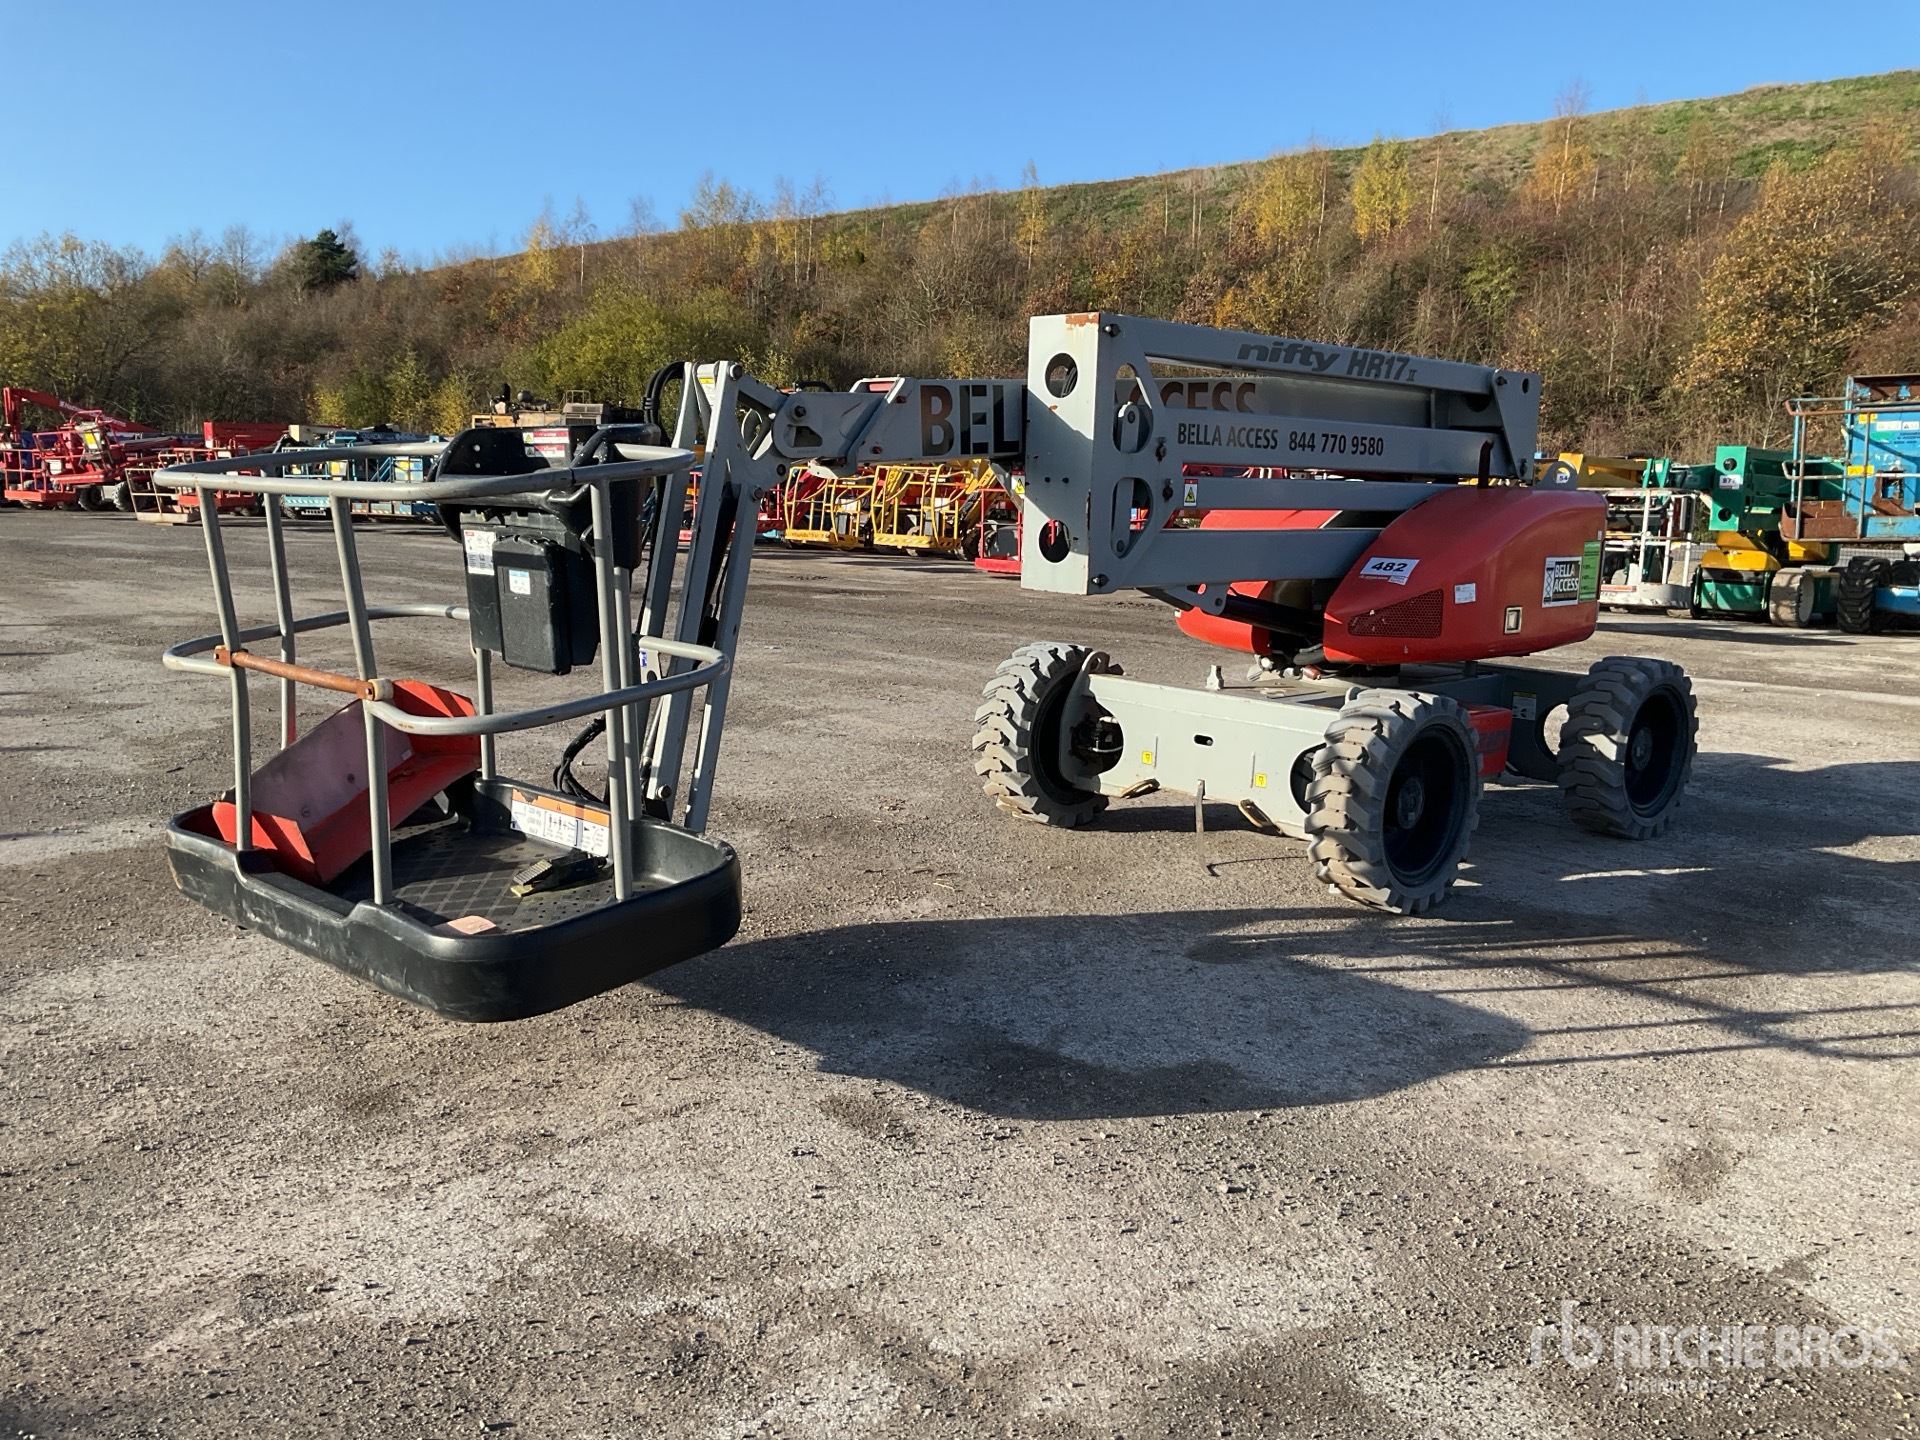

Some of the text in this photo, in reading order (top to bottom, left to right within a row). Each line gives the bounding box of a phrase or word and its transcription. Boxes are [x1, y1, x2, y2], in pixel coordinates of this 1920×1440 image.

[1237, 341, 1341, 372] nifty
[1177, 422, 1384, 456] BELLA ACCESS 844 770 9580
[1371, 561, 1408, 572] 482
[1554, 563, 1575, 577] BELLA
[1553, 577, 1579, 592] ACCESS
